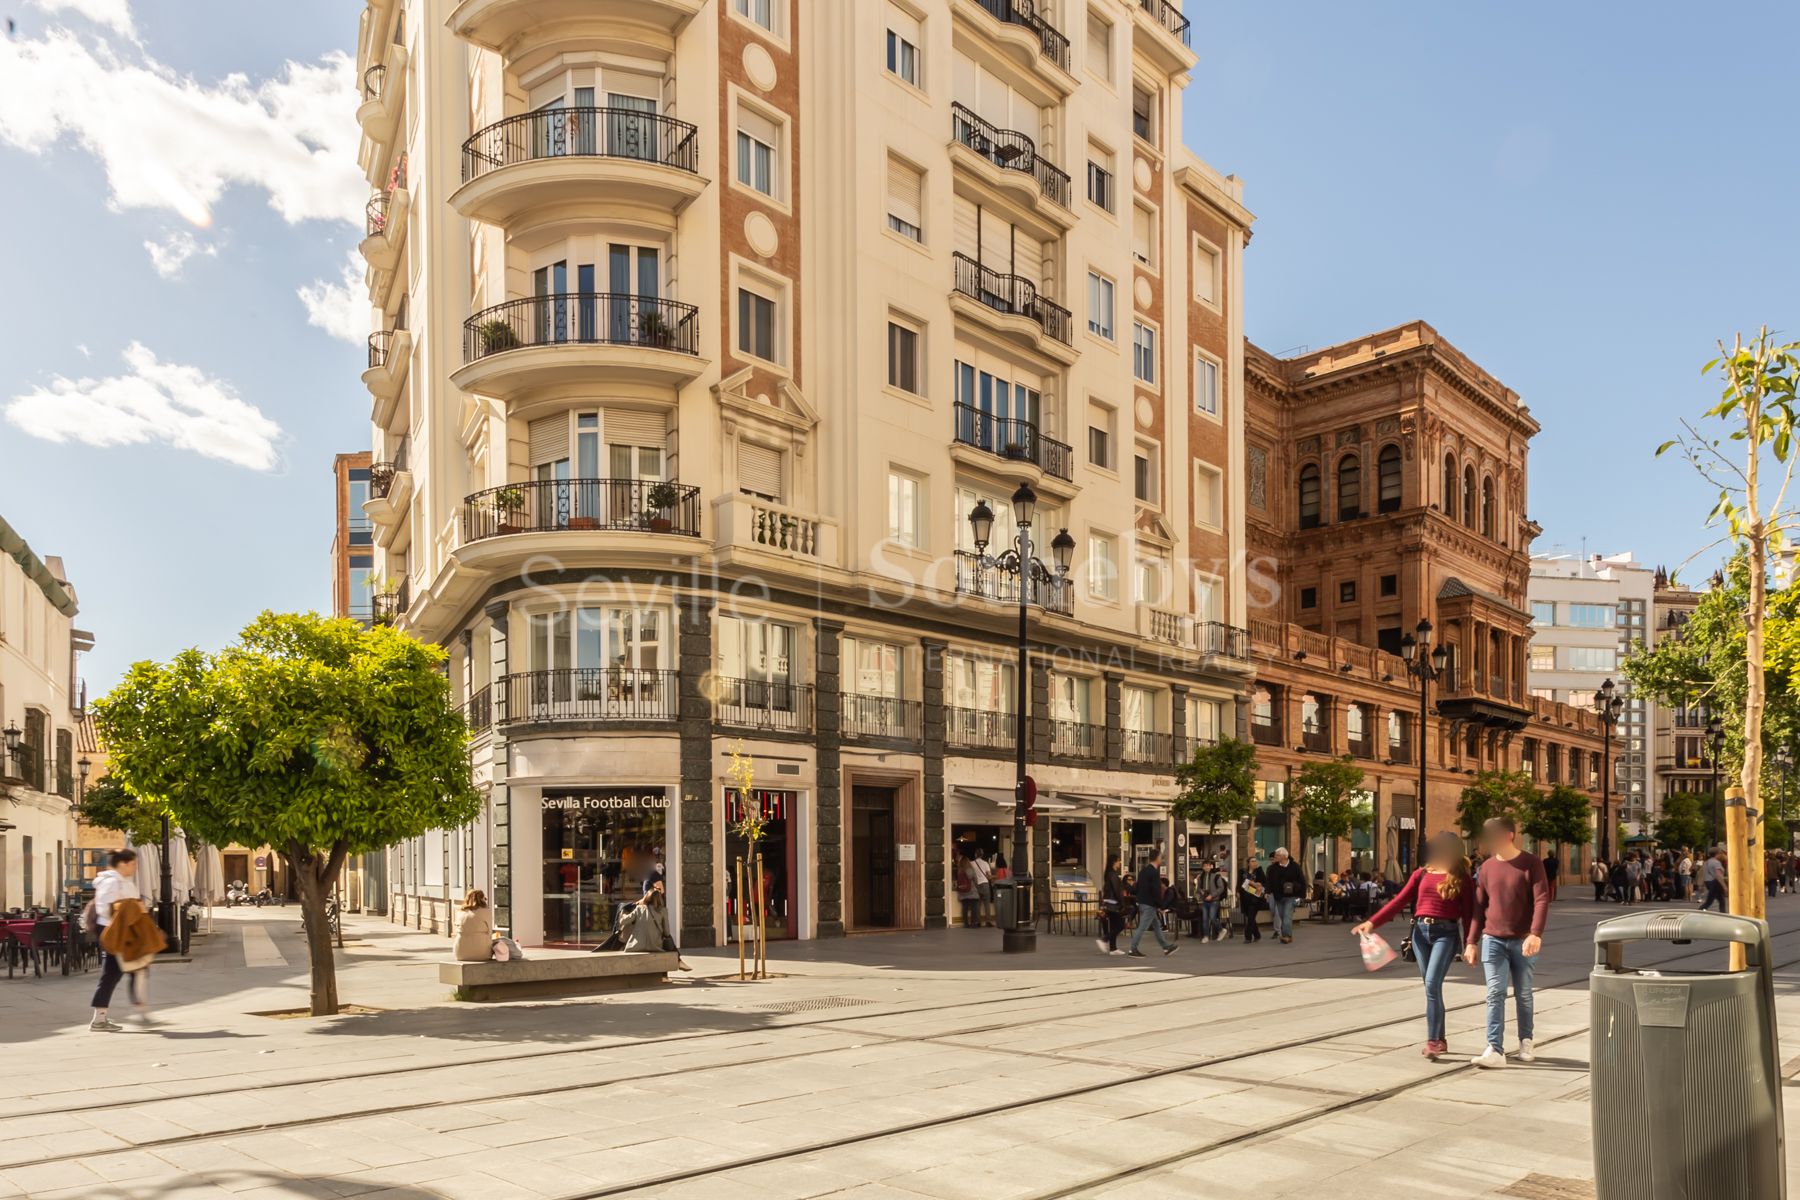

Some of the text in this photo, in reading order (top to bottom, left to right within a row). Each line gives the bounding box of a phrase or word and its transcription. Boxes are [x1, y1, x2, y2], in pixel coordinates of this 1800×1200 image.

[541, 797, 581, 809] Sevilla
[583, 796, 637, 808] Football
[641, 796, 672, 808] Club
